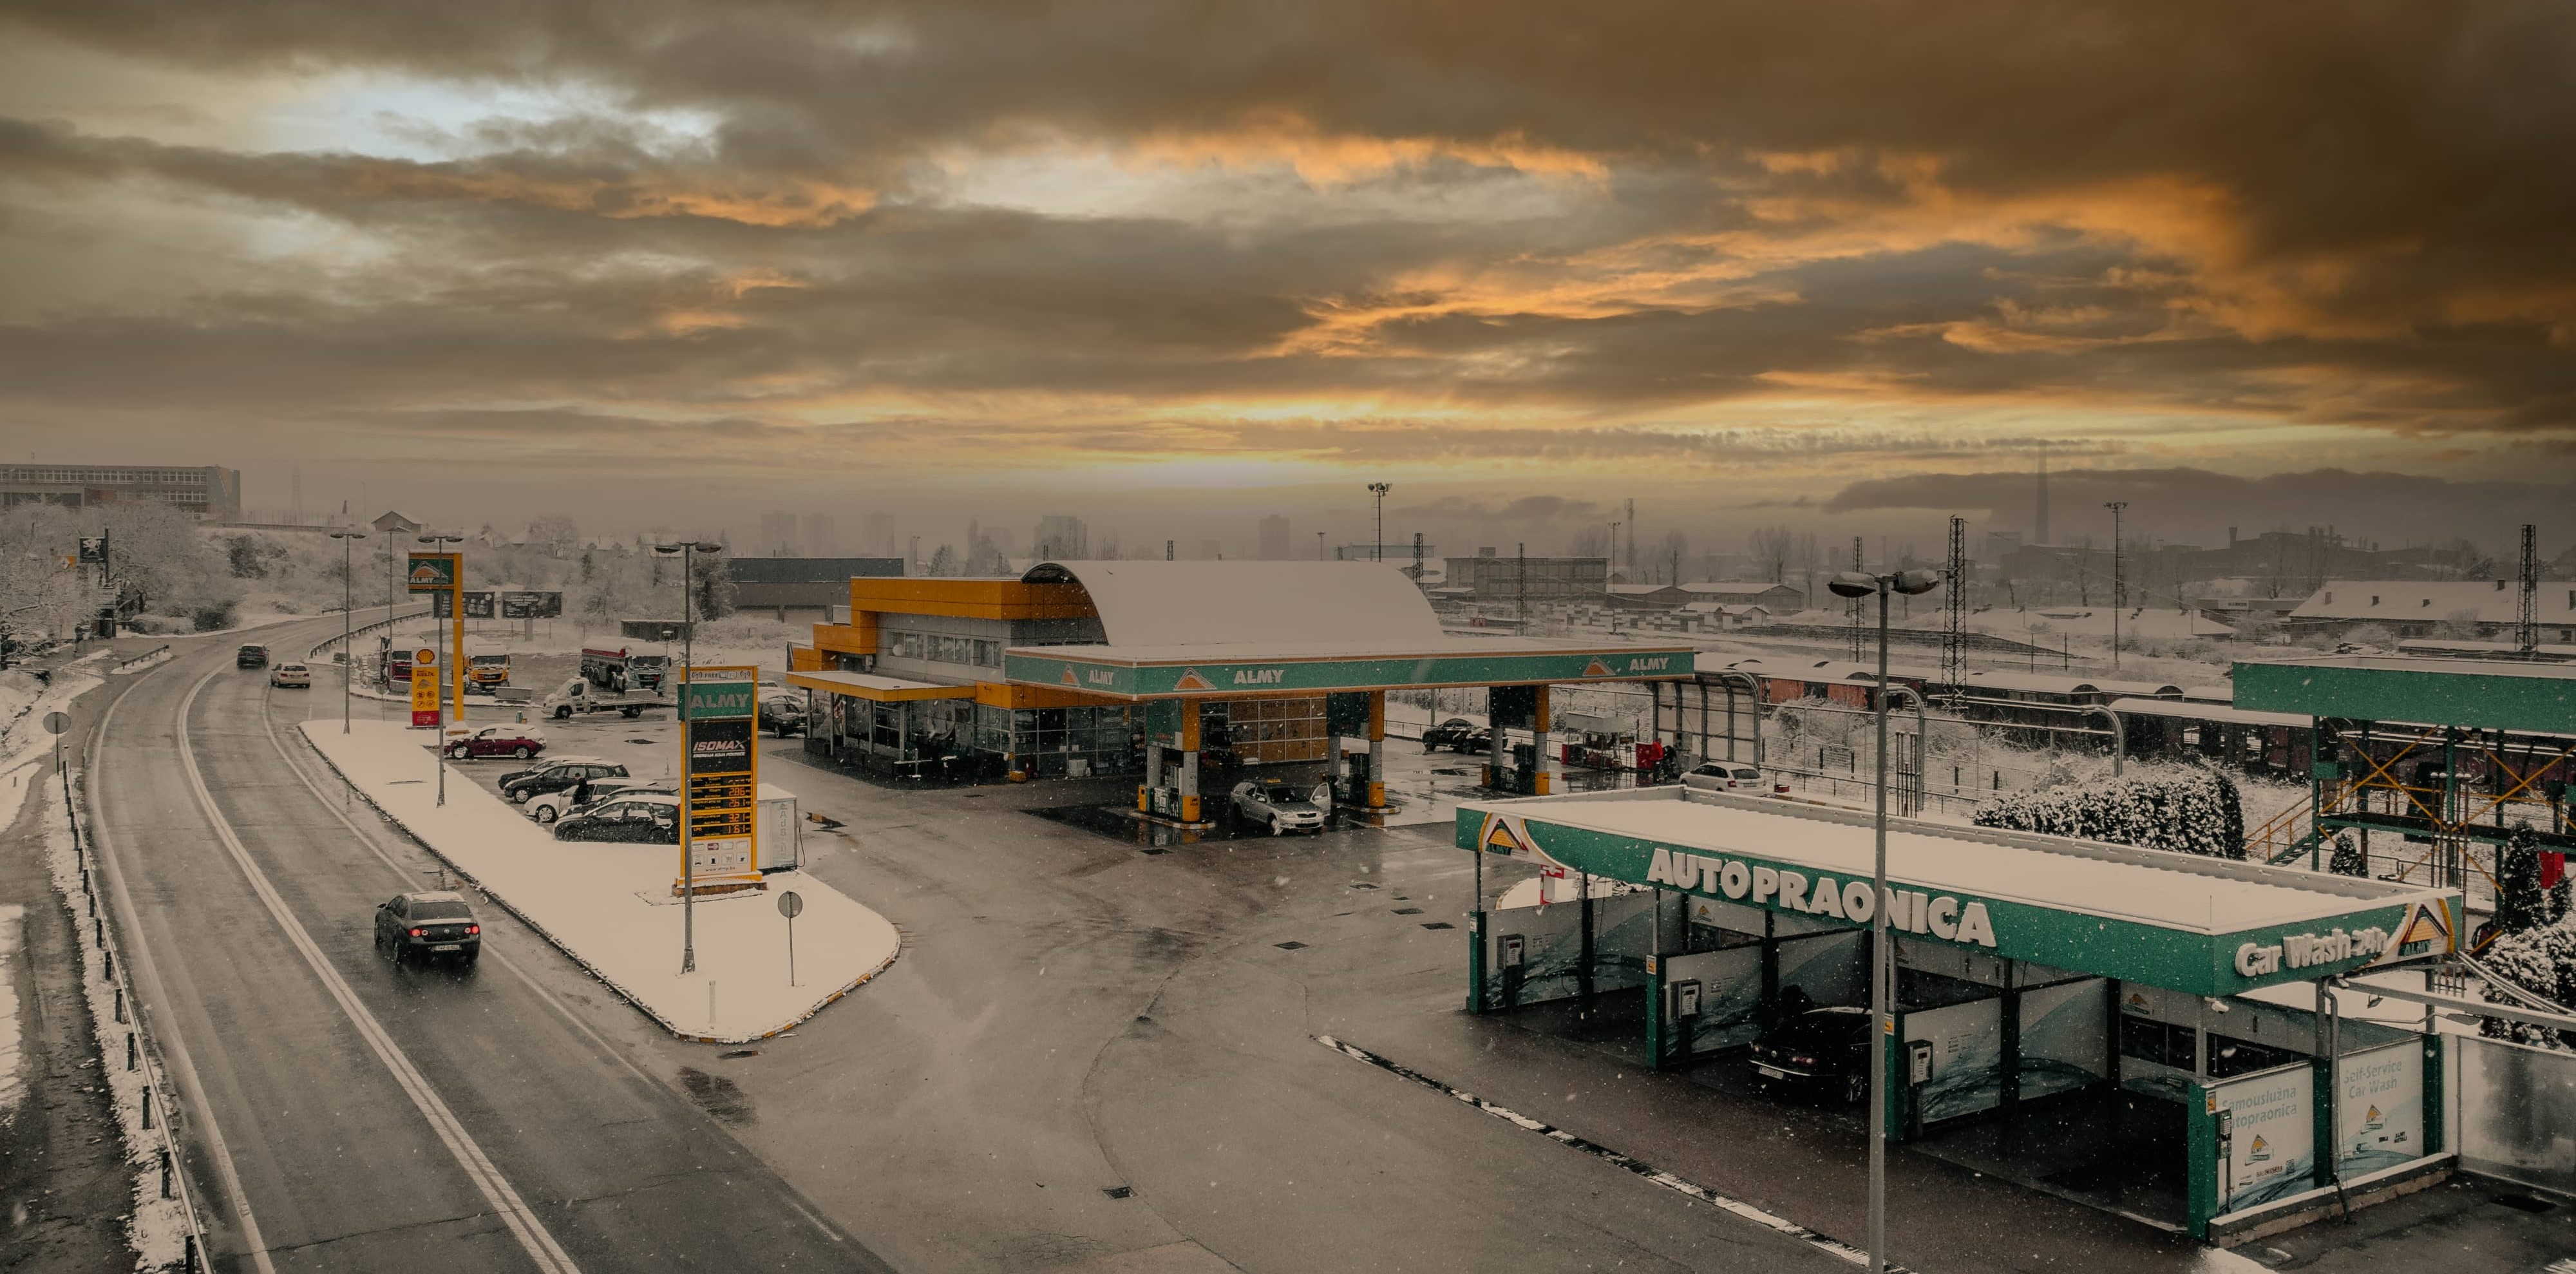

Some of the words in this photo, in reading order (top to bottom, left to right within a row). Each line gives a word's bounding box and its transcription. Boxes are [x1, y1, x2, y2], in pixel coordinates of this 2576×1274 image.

[1629, 658, 1669, 671] ALMY
[1088, 669, 1113, 685] ALMY
[1233, 670, 1284, 684] ALMY
[690, 694, 750, 708] ALMY
[693, 740, 748, 752] ISOMAX
[1646, 848, 1998, 948] AUTOPRAONICA
[2235, 942, 2282, 977] Car
[2283, 927, 2351, 969] Wash
[2351, 926, 2389, 956] 24h
[2402, 940, 2432, 956] ALMY
[2344, 1061, 2402, 1085] Self-Service
[2349, 1086, 2367, 1099] Car
[2369, 1077, 2398, 1094] Wash
